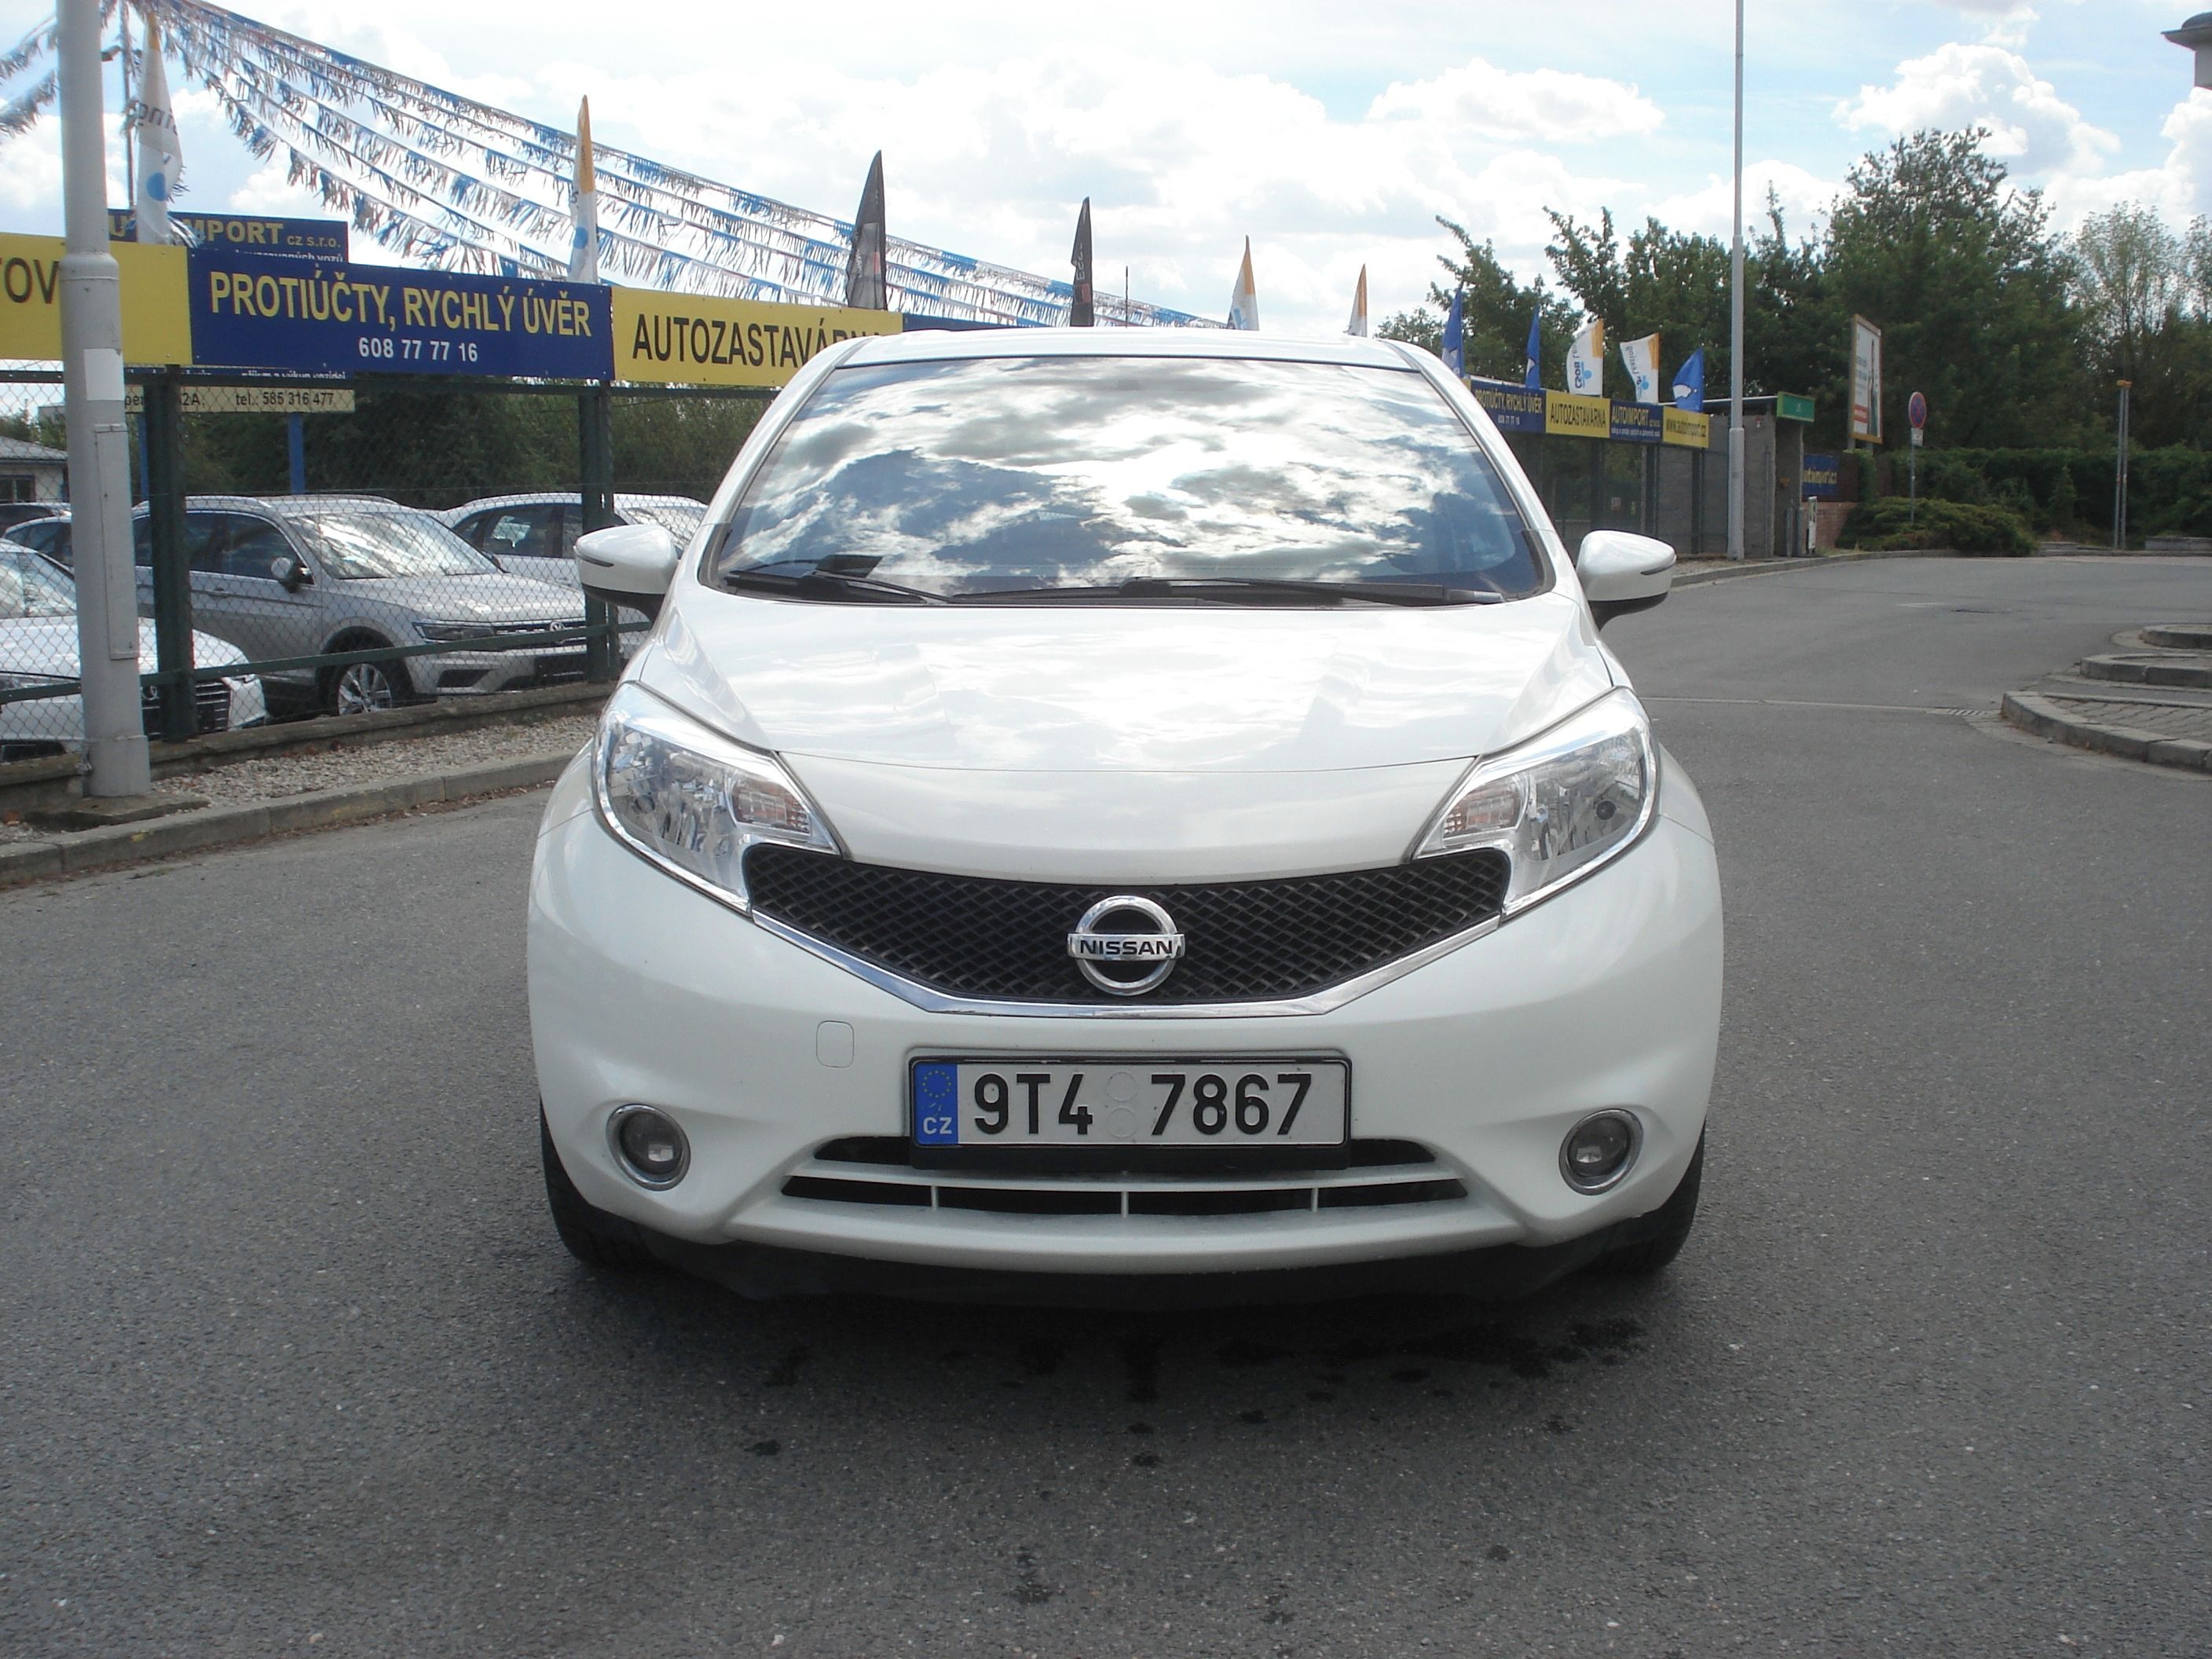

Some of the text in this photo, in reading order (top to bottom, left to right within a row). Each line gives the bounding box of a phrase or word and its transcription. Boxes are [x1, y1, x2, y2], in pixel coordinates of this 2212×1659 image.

[306, 237, 341, 247] s.r.o.
[0, 257, 60, 304] OV
[210, 271, 592, 337] PROTIÚČTY, RYCHLÝ ÚVĚR
[359, 337, 478, 362] 608 77 77 16
[632, 313, 880, 368] AUTOZASTAVÁ
[263, 393, 284, 405] 585
[288, 393, 309, 406] 316
[313, 393, 335, 406] 477
[1080, 939, 1173, 955] NISSAN
[974, 1073, 1313, 1135] 9T4 7867
[922, 1116, 953, 1135] CZ
